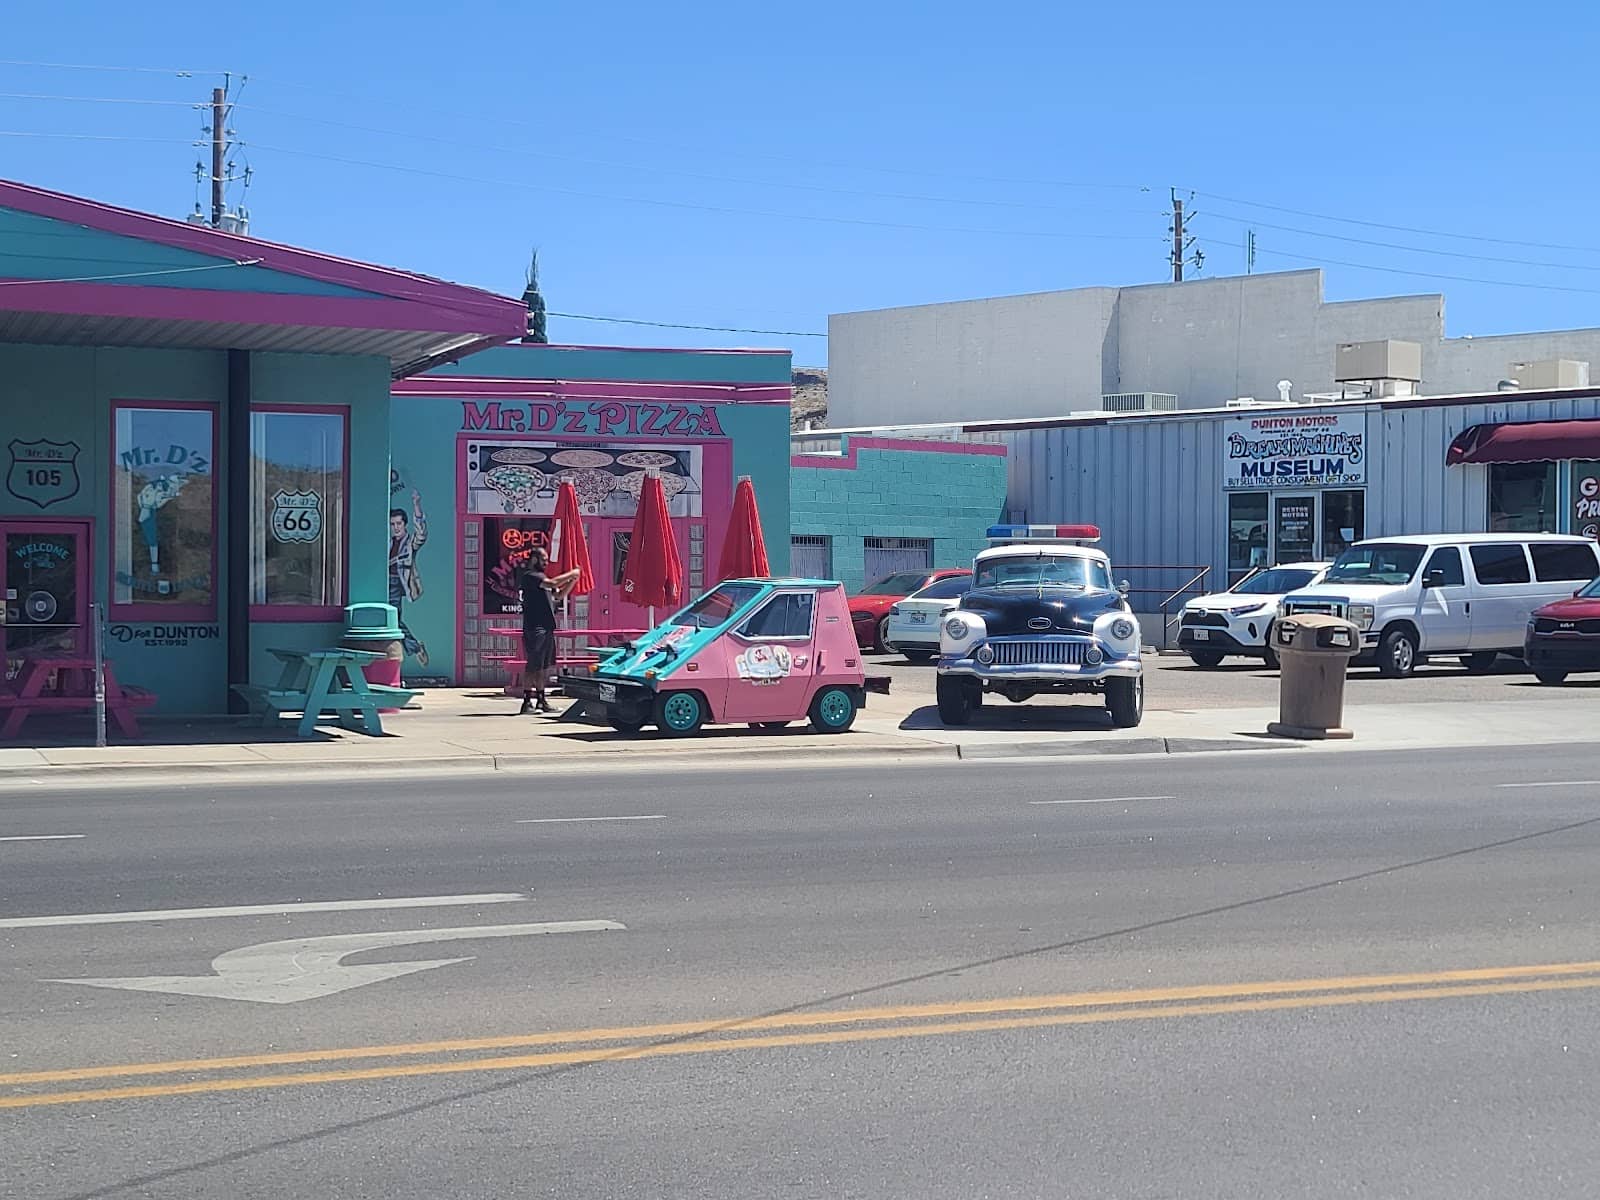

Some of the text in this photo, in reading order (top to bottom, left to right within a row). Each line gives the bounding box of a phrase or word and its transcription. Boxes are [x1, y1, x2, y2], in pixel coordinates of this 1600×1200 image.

[461, 401, 726, 436] Mr. D'z PIZZA
[1252, 416, 1338, 429] DUNTON MOTORS
[121, 445, 209, 473] Mr. D'z
[1241, 459, 1344, 477] MUSEUM
[26, 469, 61, 486] 105
[1228, 478, 1239, 486] BUY
[1241, 478, 1254, 486] SELL
[1276, 475, 1324, 484] CONSIGNMENT
[1325, 474, 1341, 483] GIFT
[1343, 473, 1361, 482] SHOP
[284, 510, 311, 531] 66
[503, 528, 550, 549] OPEN
[15, 542, 70, 560] WELCOME
[110, 625, 133, 642] D
[153, 626, 219, 639] DUNTON
